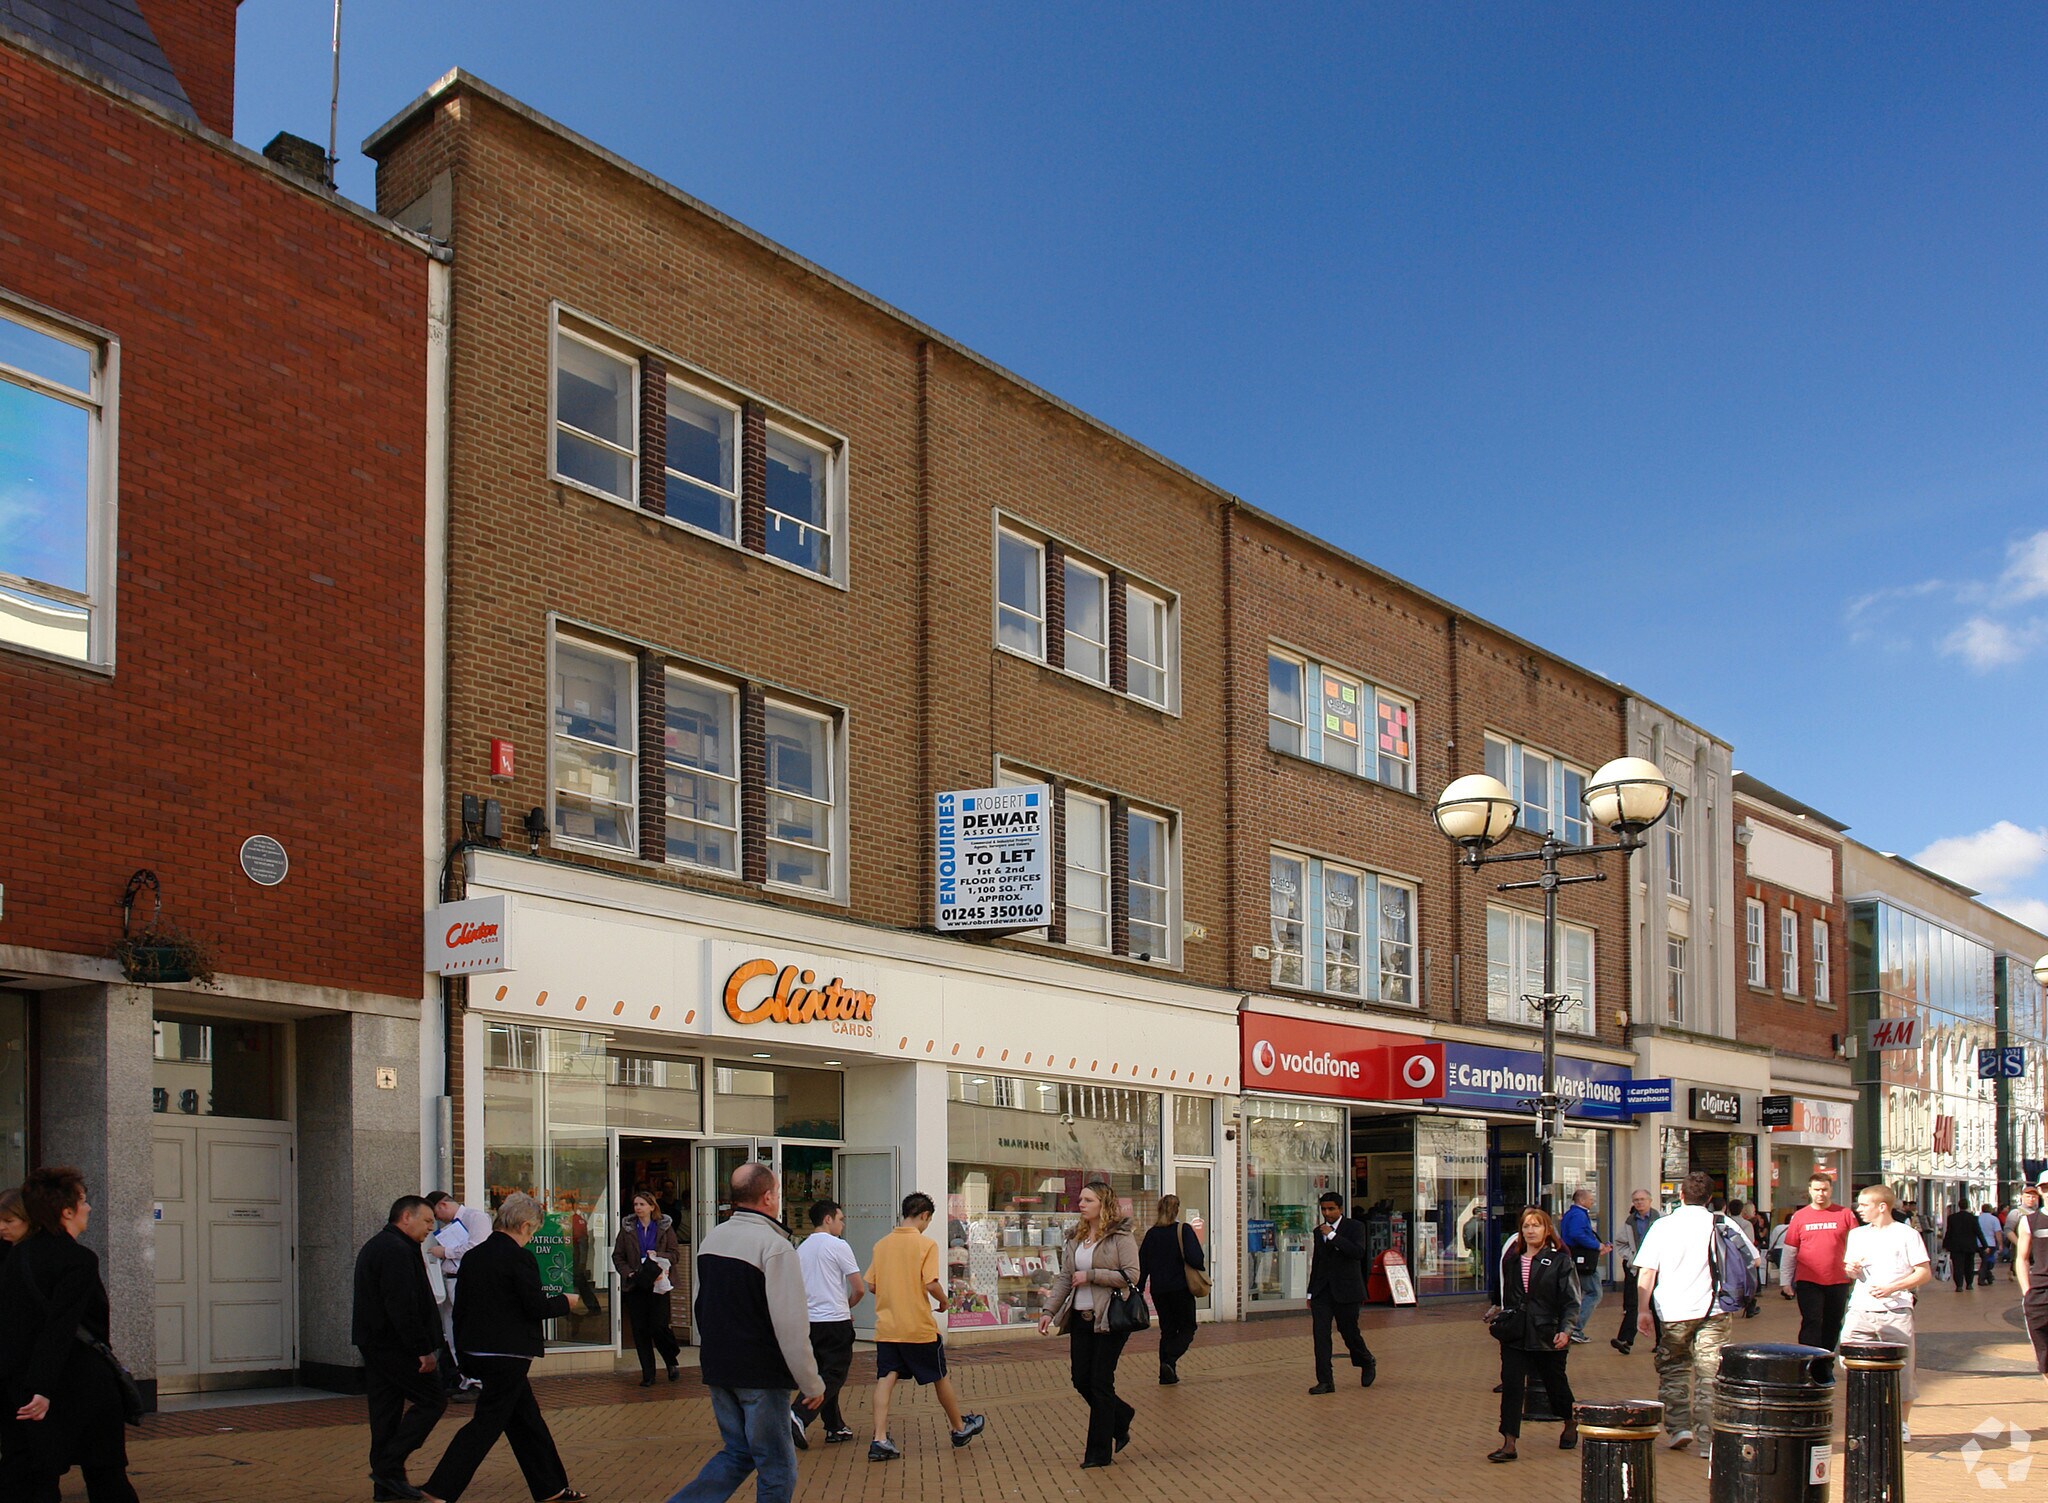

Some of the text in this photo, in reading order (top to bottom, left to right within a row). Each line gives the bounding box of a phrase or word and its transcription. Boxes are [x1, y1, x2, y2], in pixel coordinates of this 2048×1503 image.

[977, 795, 1023, 810] ROBERT
[963, 811, 1038, 828] DEWAR
[963, 825, 1040, 836] ASSOCIATES
[939, 794, 955, 904] ENQUIRIES
[965, 849, 1035, 865] TO LET
[960, 874, 1041, 885] FLOOR OFFICES
[968, 886, 995, 894] 1,100
[977, 894, 1023, 902] APPROX.
[942, 904, 1043, 920] 01245 350160
[947, 917, 1039, 927] www.robertdewar.co.uk
[446, 922, 498, 948] Clinton
[723, 958, 876, 1024] Clinton
[831, 1021, 873, 1038] CARDS
[1873, 1021, 1915, 1047] H&M
[1280, 1050, 1360, 1079] vodafone
[2005, 1055, 2022, 1076] S
[1631, 1087, 1670, 1096] Carphone
[1803, 1108, 1842, 1140] Orange
[536, 1246, 551, 1254] DAY
